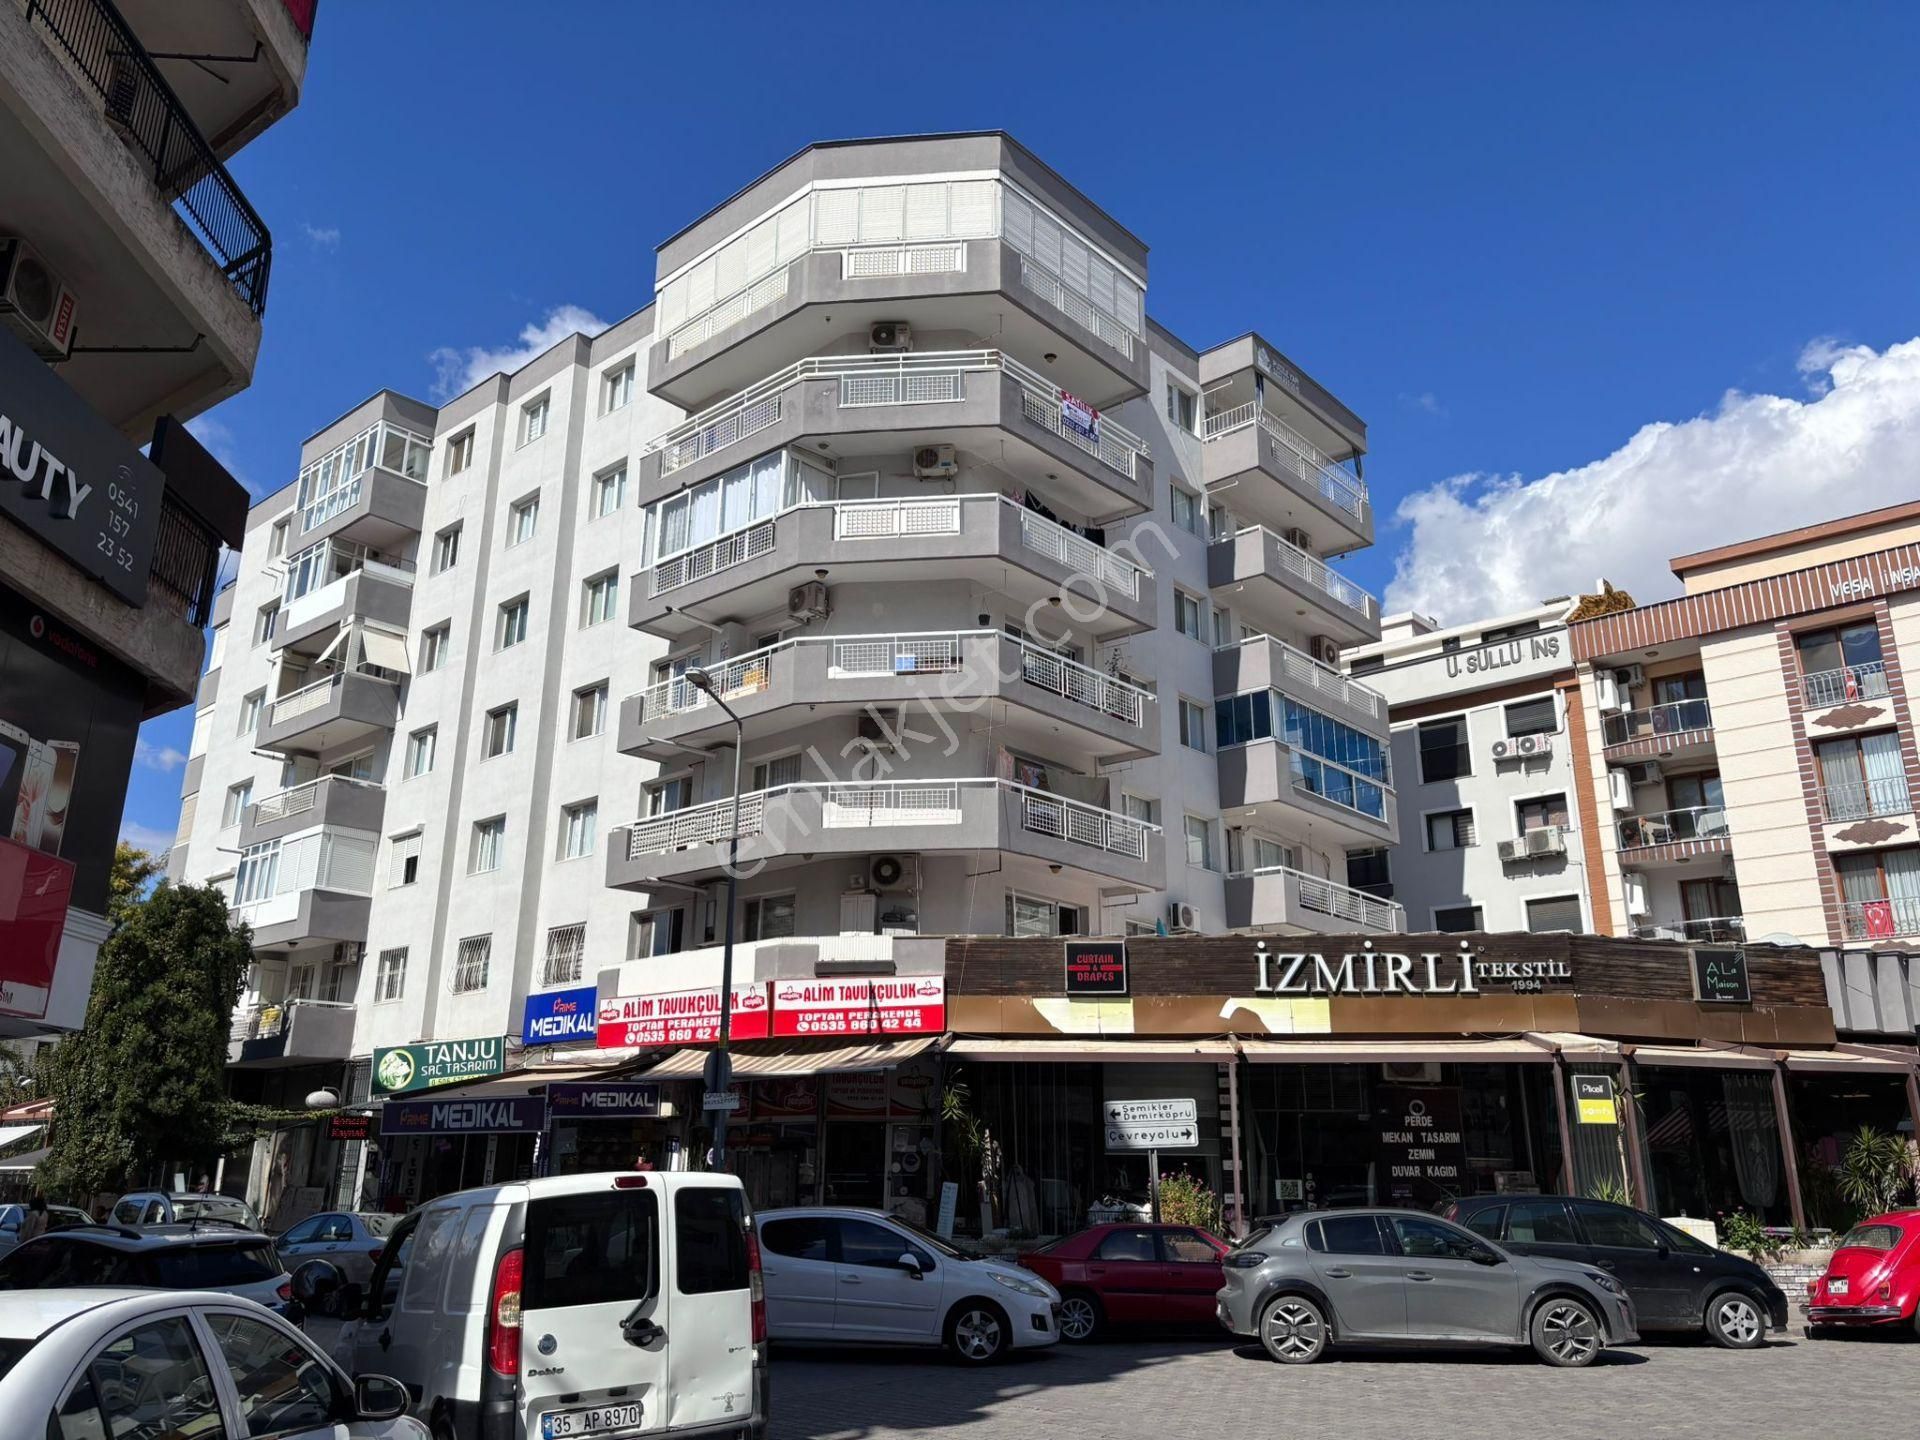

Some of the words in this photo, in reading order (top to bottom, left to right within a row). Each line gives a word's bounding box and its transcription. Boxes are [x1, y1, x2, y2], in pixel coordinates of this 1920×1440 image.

[108, 482, 139, 519] 0541
[109, 510, 130, 538] 157
[97, 532, 114, 557] 23
[117, 547, 134, 572] 52
[1831, 577, 1871, 597] VESA
[1077, 954, 1114, 964] CURTAIN
[1254, 940, 1479, 992] İZMİRLİ
[1475, 958, 1572, 978] TEKSTİL
[1706, 961, 1720, 975] A
[1077, 972, 1114, 982] DRAPES
[1511, 980, 1542, 990] 1994
[1706, 976, 1739, 990] Maison
[803, 983, 834, 1003] ALİM
[839, 982, 917, 1003] TAVUKÇULUK
[623, 997, 654, 1019] ALİM
[658, 991, 739, 1017] TAVUKÇULK
[798, 1012, 844, 1022] TOPTAN
[848, 1009, 921, 1021] PERAKENDE
[530, 1012, 595, 1038] MEDIKAL
[627, 1020, 665, 1033] TOPTAN
[667, 1015, 732, 1029] PERAKEN
[811, 1020, 846, 1031] 0535
[851, 1019, 877, 1030] 860
[882, 1018, 899, 1029] 42
[904, 1017, 922, 1028] 44
[636, 1029, 665, 1043] 0535
[669, 1028, 691, 1042] 860
[697, 1027, 711, 1040] 42
[425, 1040, 496, 1064] TANJU
[446, 1059, 497, 1074] TASARIM
[581, 1092, 655, 1108] MEDIKAL
[431, 1102, 523, 1129] MEDIKAL
[1404, 1116, 1433, 1127] PERDE
[1109, 1129, 1179, 1142] Çevreyolu
[1382, 1132, 1413, 1143] MEKAN
[1420, 1132, 1460, 1143] TASARIM
[1391, 1166, 1420, 1177] DUVAR
[554, 1415, 572, 1434] 35
[583, 1411, 601, 1431] AP
[604, 1406, 638, 1426] 8970
